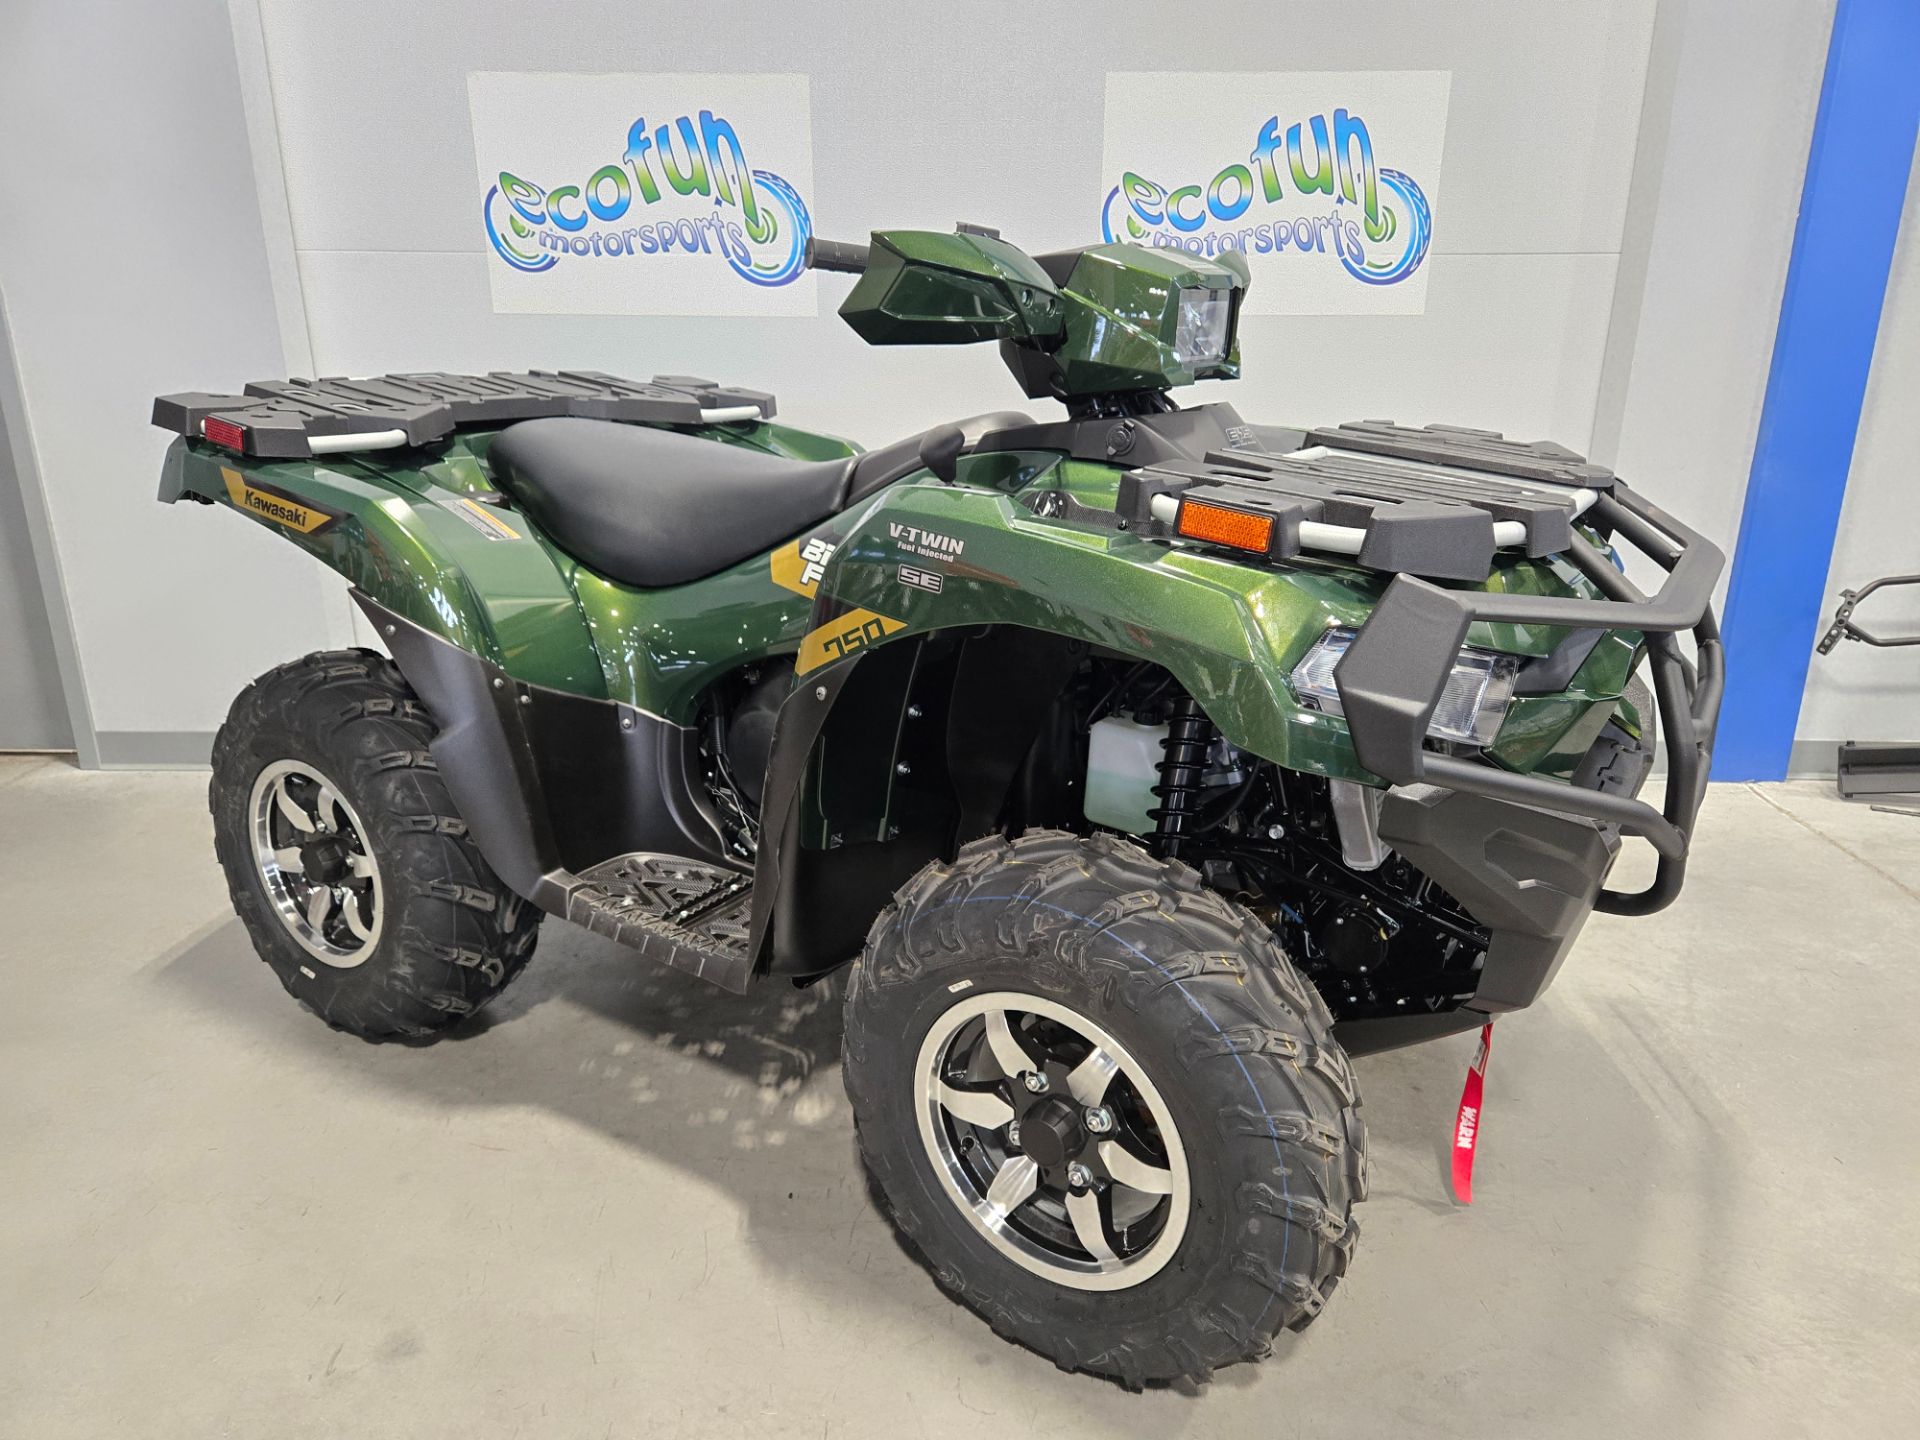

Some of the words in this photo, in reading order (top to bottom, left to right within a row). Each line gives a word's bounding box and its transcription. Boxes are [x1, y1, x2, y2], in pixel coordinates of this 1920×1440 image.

[498, 110, 760, 232] ecofun
[1122, 108, 1379, 232] ecofun
[538, 211, 752, 266] motorsports
[1153, 210, 1365, 266] motorsports
[244, 489, 307, 527] Kawasaki
[890, 522, 964, 555] V-TWIN
[899, 567, 941, 591] SE
[823, 618, 886, 657] 750
[1457, 1105, 1477, 1149] WARN
